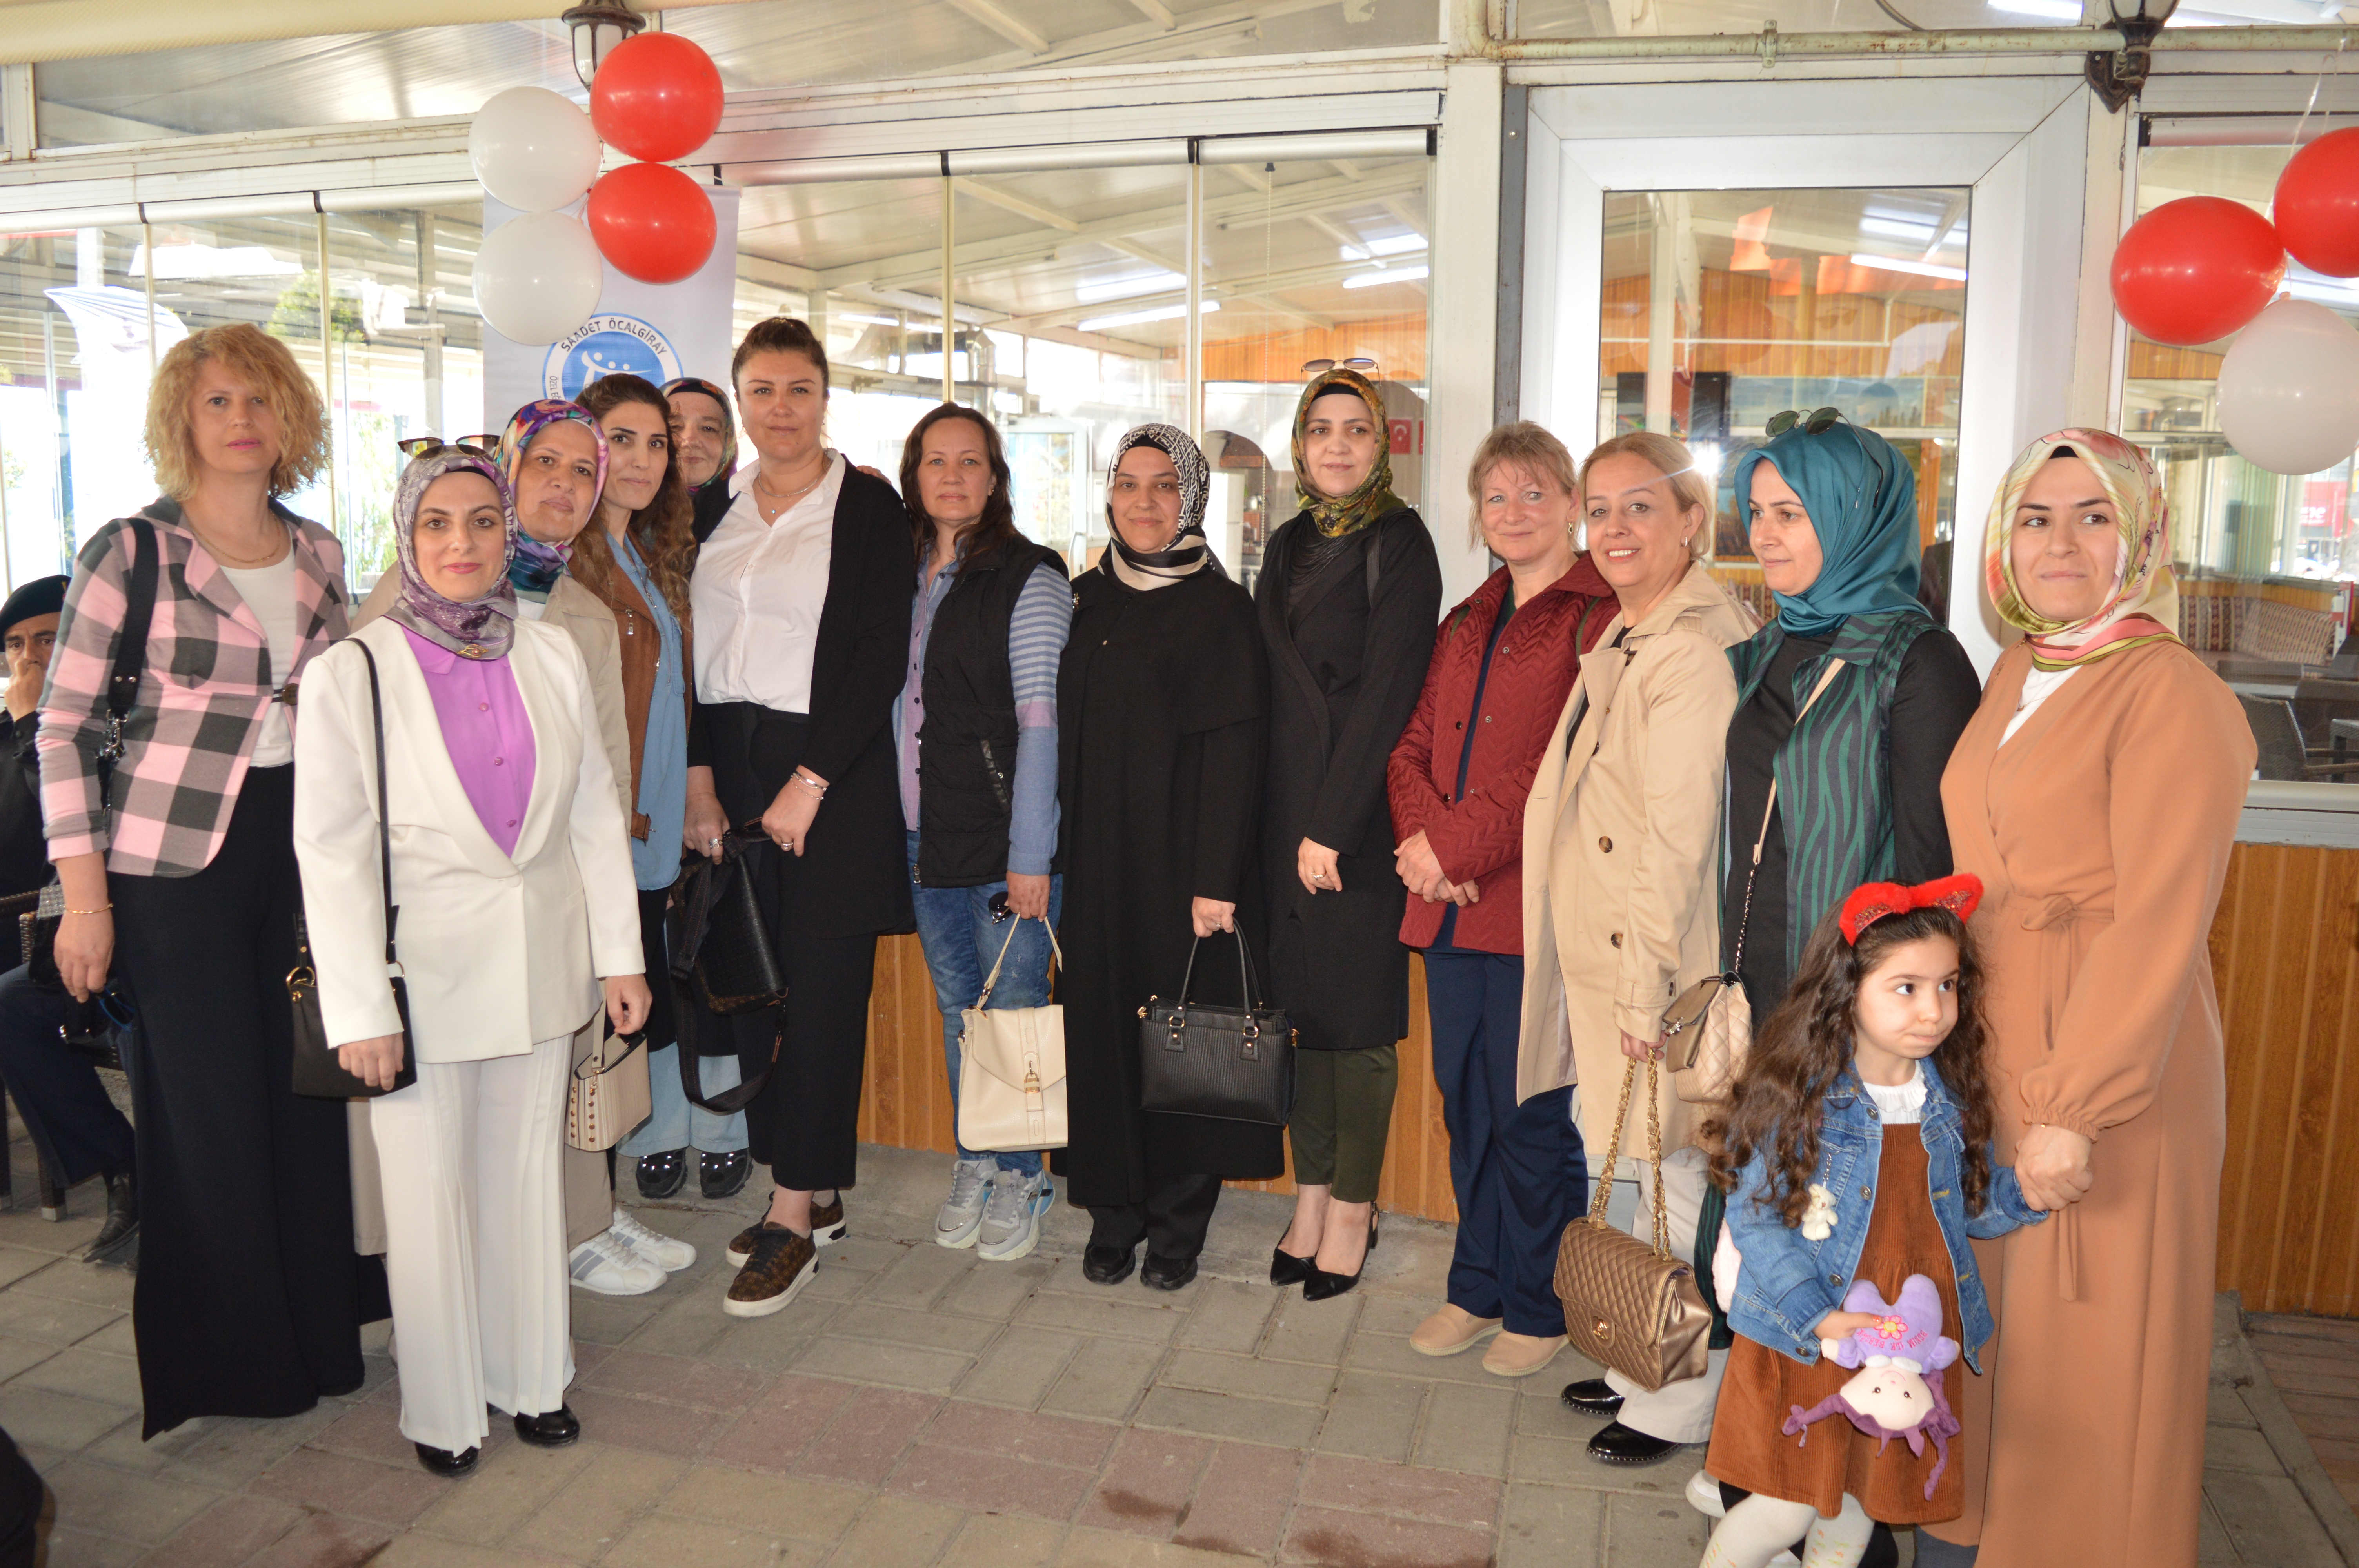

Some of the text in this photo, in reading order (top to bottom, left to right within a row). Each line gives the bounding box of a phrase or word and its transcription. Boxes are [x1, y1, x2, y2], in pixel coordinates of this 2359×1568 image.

[561, 318, 667, 355] SAADET ÖCALGİRAY
[549, 376, 559, 391] ÖZEL
